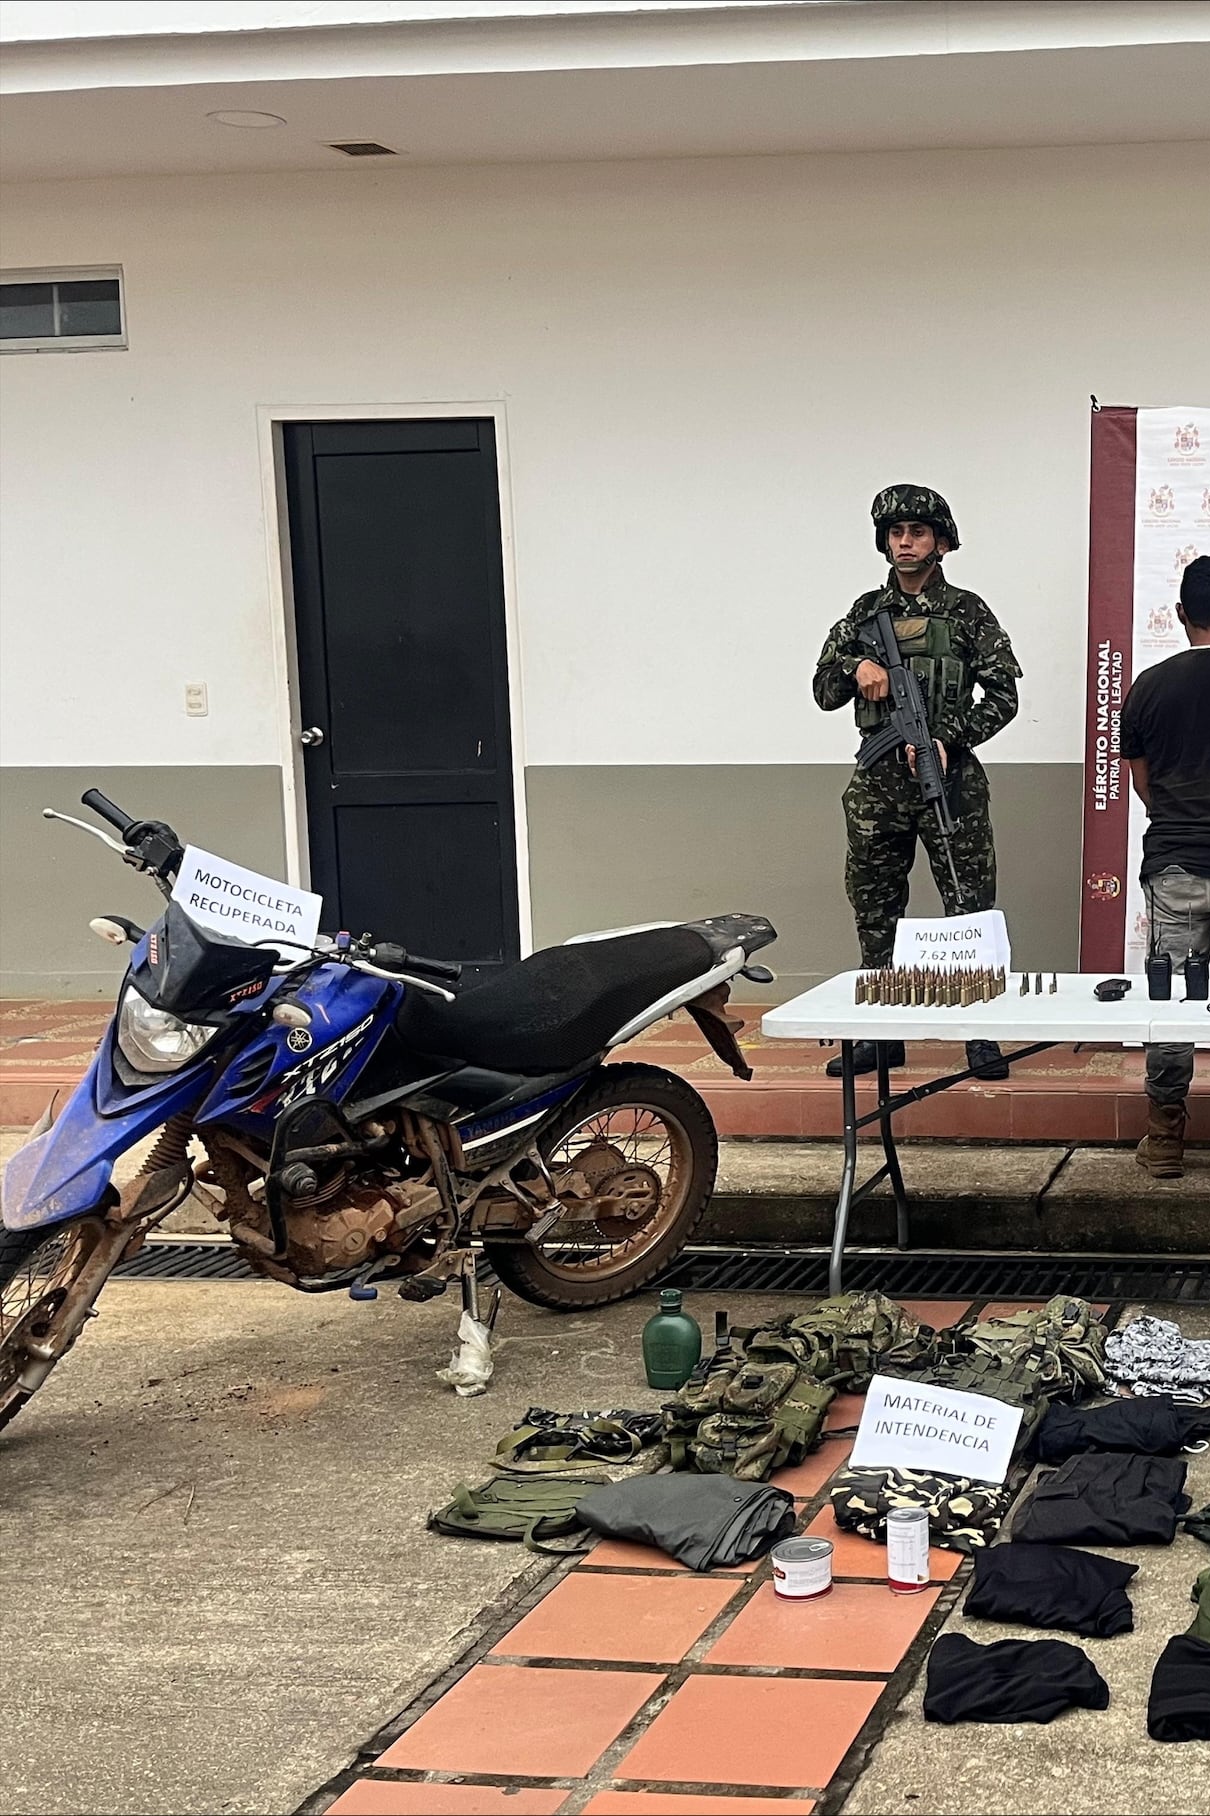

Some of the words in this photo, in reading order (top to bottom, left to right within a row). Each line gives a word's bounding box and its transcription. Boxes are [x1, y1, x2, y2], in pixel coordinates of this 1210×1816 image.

[1097, 640, 1110, 730] NACIONAL
[1111, 651, 1122, 704] LEALTAD
[1110, 709, 1121, 753] HONOR
[1093, 736, 1109, 811] EJÉRCITO
[1109, 758, 1121, 800] PATRIA
[189, 893, 296, 935] RECUPERADA
[194, 869, 302, 917] MOTOCICLETA
[915, 927, 982, 943] MUNICIÓN
[920, 951, 946, 961] 7.62
[952, 949, 976, 961] MM
[281, 1014, 374, 1084] XTZ150
[883, 1394, 969, 1424] MATERIAL
[974, 1414, 997, 1430] DE
[874, 1420, 989, 1452] INTENDENCIA
